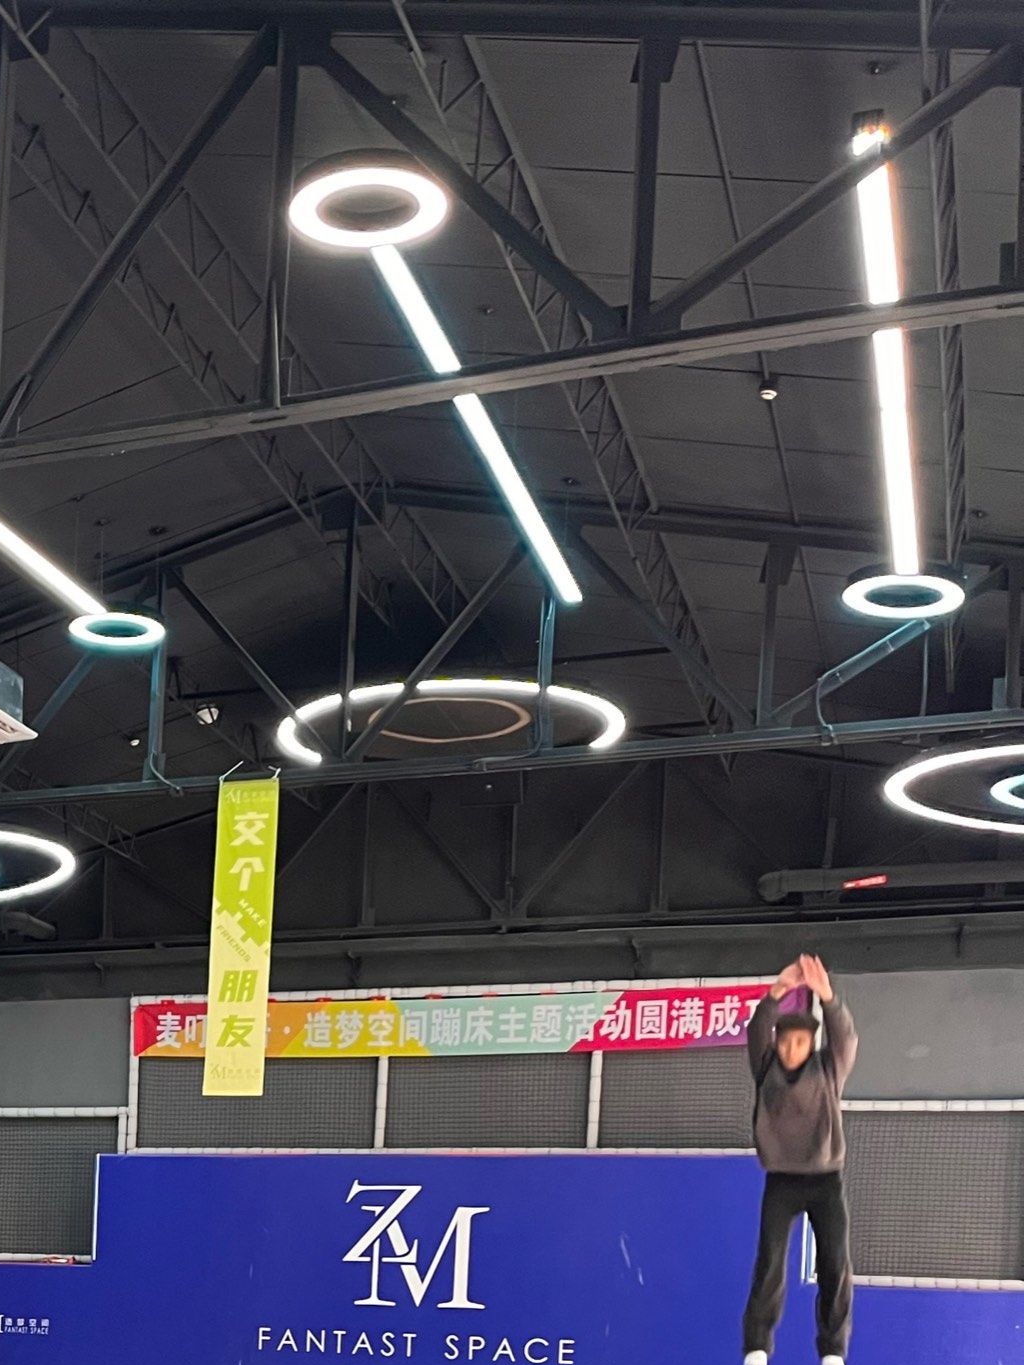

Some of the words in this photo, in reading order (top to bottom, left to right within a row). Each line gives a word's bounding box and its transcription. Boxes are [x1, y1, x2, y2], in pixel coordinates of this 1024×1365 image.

[238, 899, 267, 928] MAKE
[156, 995, 760, 1049] 麦叮·造梦空间蹦床主题活动圆满成
[258, 1327, 417, 1357] FANTAST
[444, 1335, 575, 1365] SPACE
